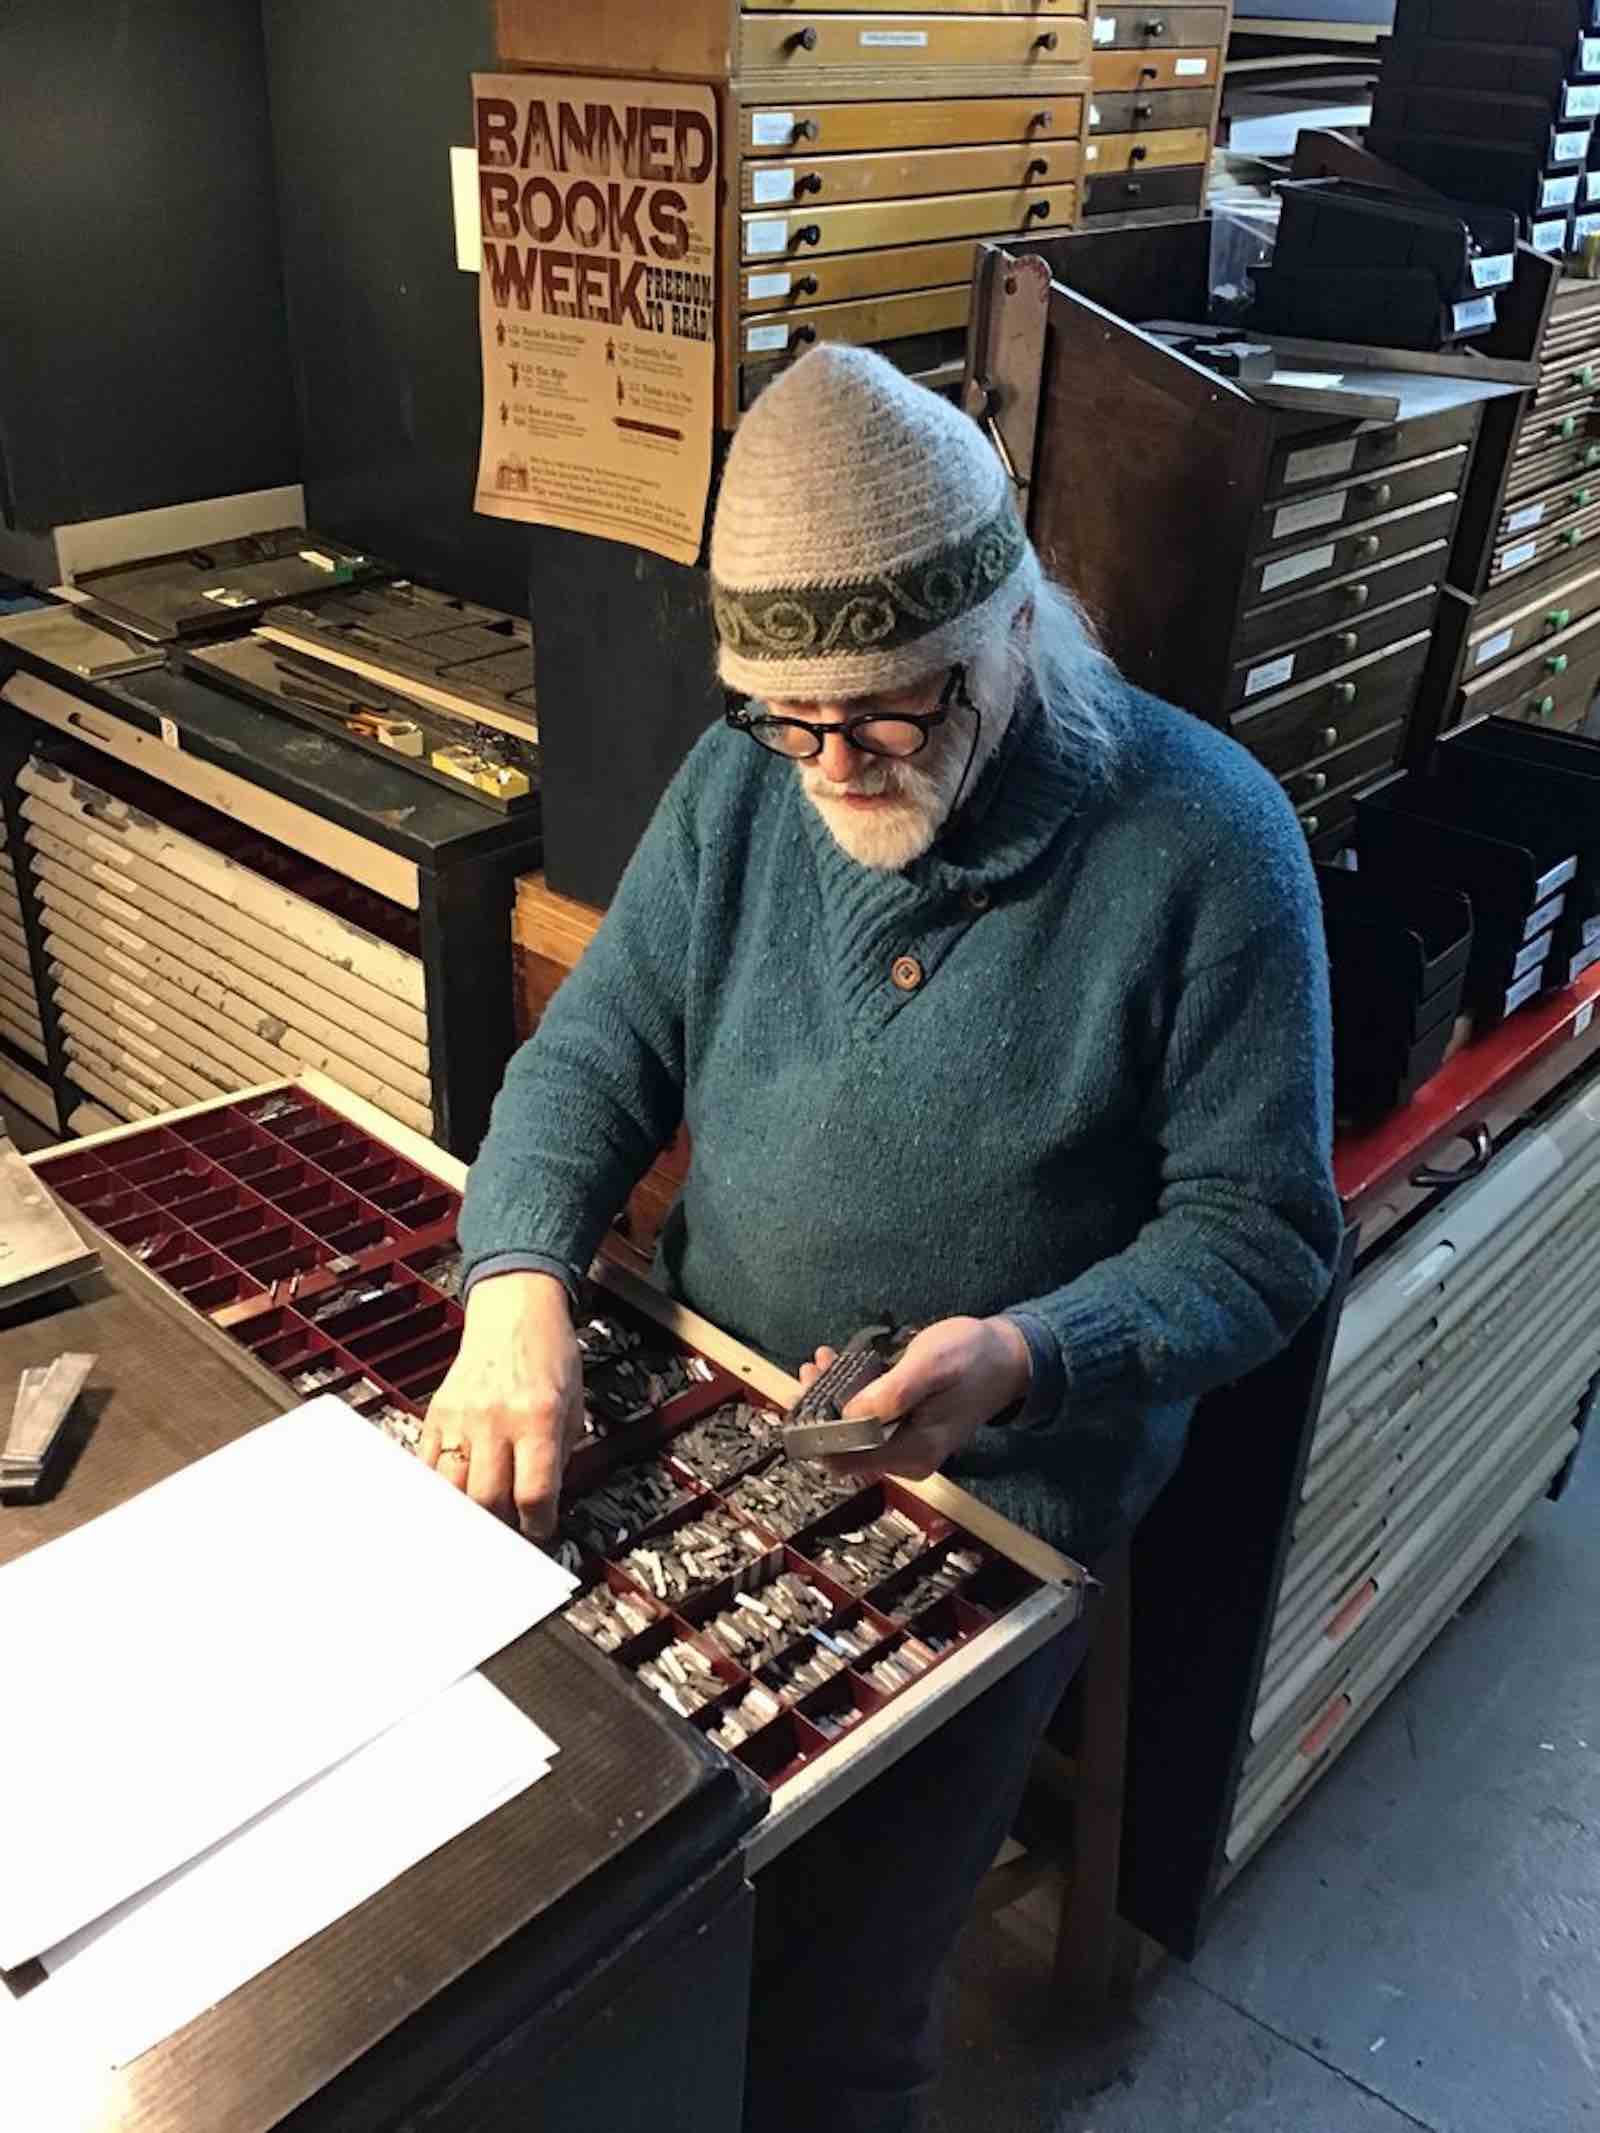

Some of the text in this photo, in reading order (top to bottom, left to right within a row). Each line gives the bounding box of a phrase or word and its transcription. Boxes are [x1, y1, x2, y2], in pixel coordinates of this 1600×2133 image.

[476, 98, 714, 184] BANNED
[479, 171, 690, 261] BOOKS
[483, 243, 653, 330] WEEK
[646, 265, 712, 308] FREEDOM
[646, 299, 664, 334] TO
